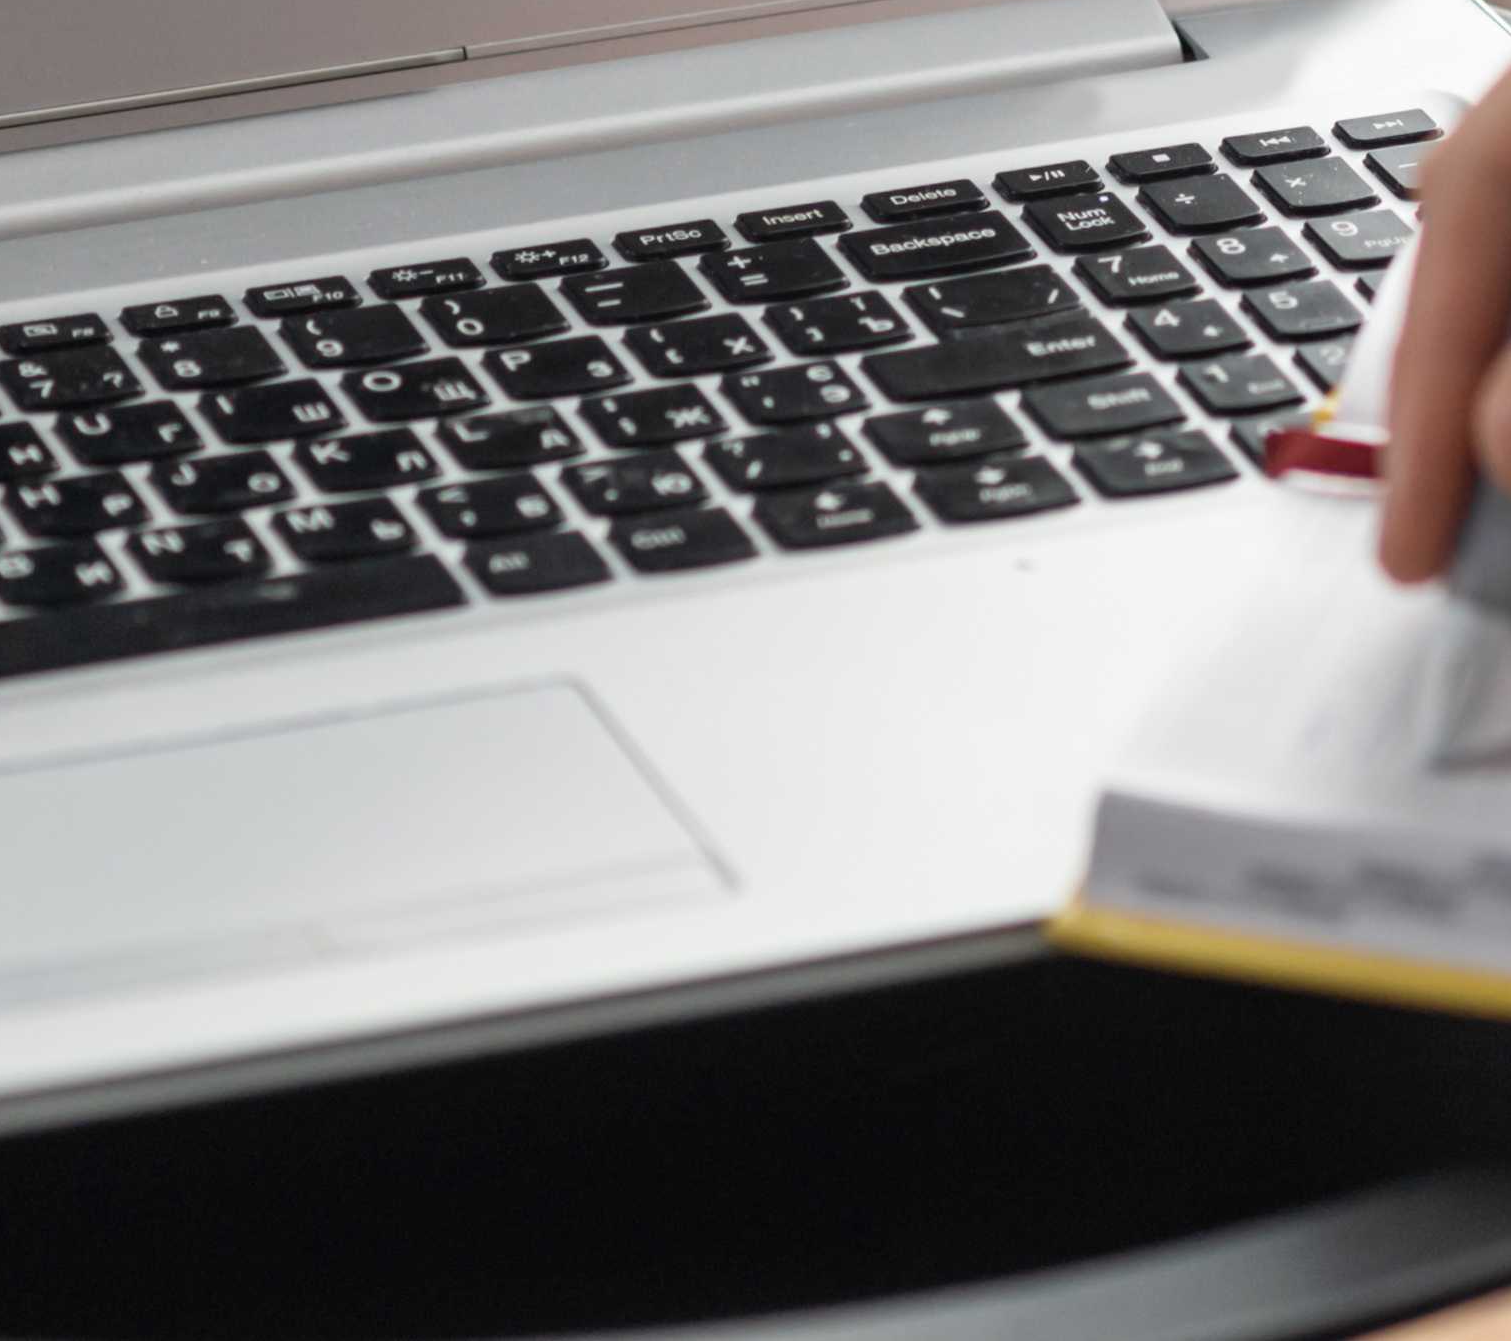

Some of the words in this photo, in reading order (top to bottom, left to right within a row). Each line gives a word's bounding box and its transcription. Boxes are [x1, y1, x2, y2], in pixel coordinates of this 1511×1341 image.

[889, 186, 958, 206] Delete
[761, 207, 824, 226] Insert
[1056, 207, 1108, 223] Num
[1064, 215, 1116, 232] Lock
[638, 226, 703, 246] PrtSc
[1330, 220, 1359, 237] 9
[869, 226, 997, 256] Backspace
[1215, 237, 1247, 255] 8
[558, 253, 590, 266] F12
[1097, 254, 1123, 274] 7
[435, 271, 465, 284] F11
[1127, 271, 1180, 287] Home
[311, 289, 345, 304] F10
[1268, 290, 1299, 310] 5
[456, 318, 485, 336] 0
[1153, 308, 1181, 327] 4
[315, 338, 344, 358] 9
[1025, 334, 1097, 357] Enter
[172, 359, 202, 378] 8
[499, 349, 532, 372] P
[361, 370, 402, 393] O
[1202, 363, 1230, 384] 1
[29, 379, 55, 399] 7
[1087, 387, 1152, 410] Shift
[292, 401, 331, 423] Ш
[72, 412, 112, 436] U
[453, 419, 489, 443] L
[309, 440, 349, 465] K
[171, 462, 197, 486] J
[18, 483, 61, 509] H
[285, 506, 335, 533] M
[141, 529, 185, 556] N
